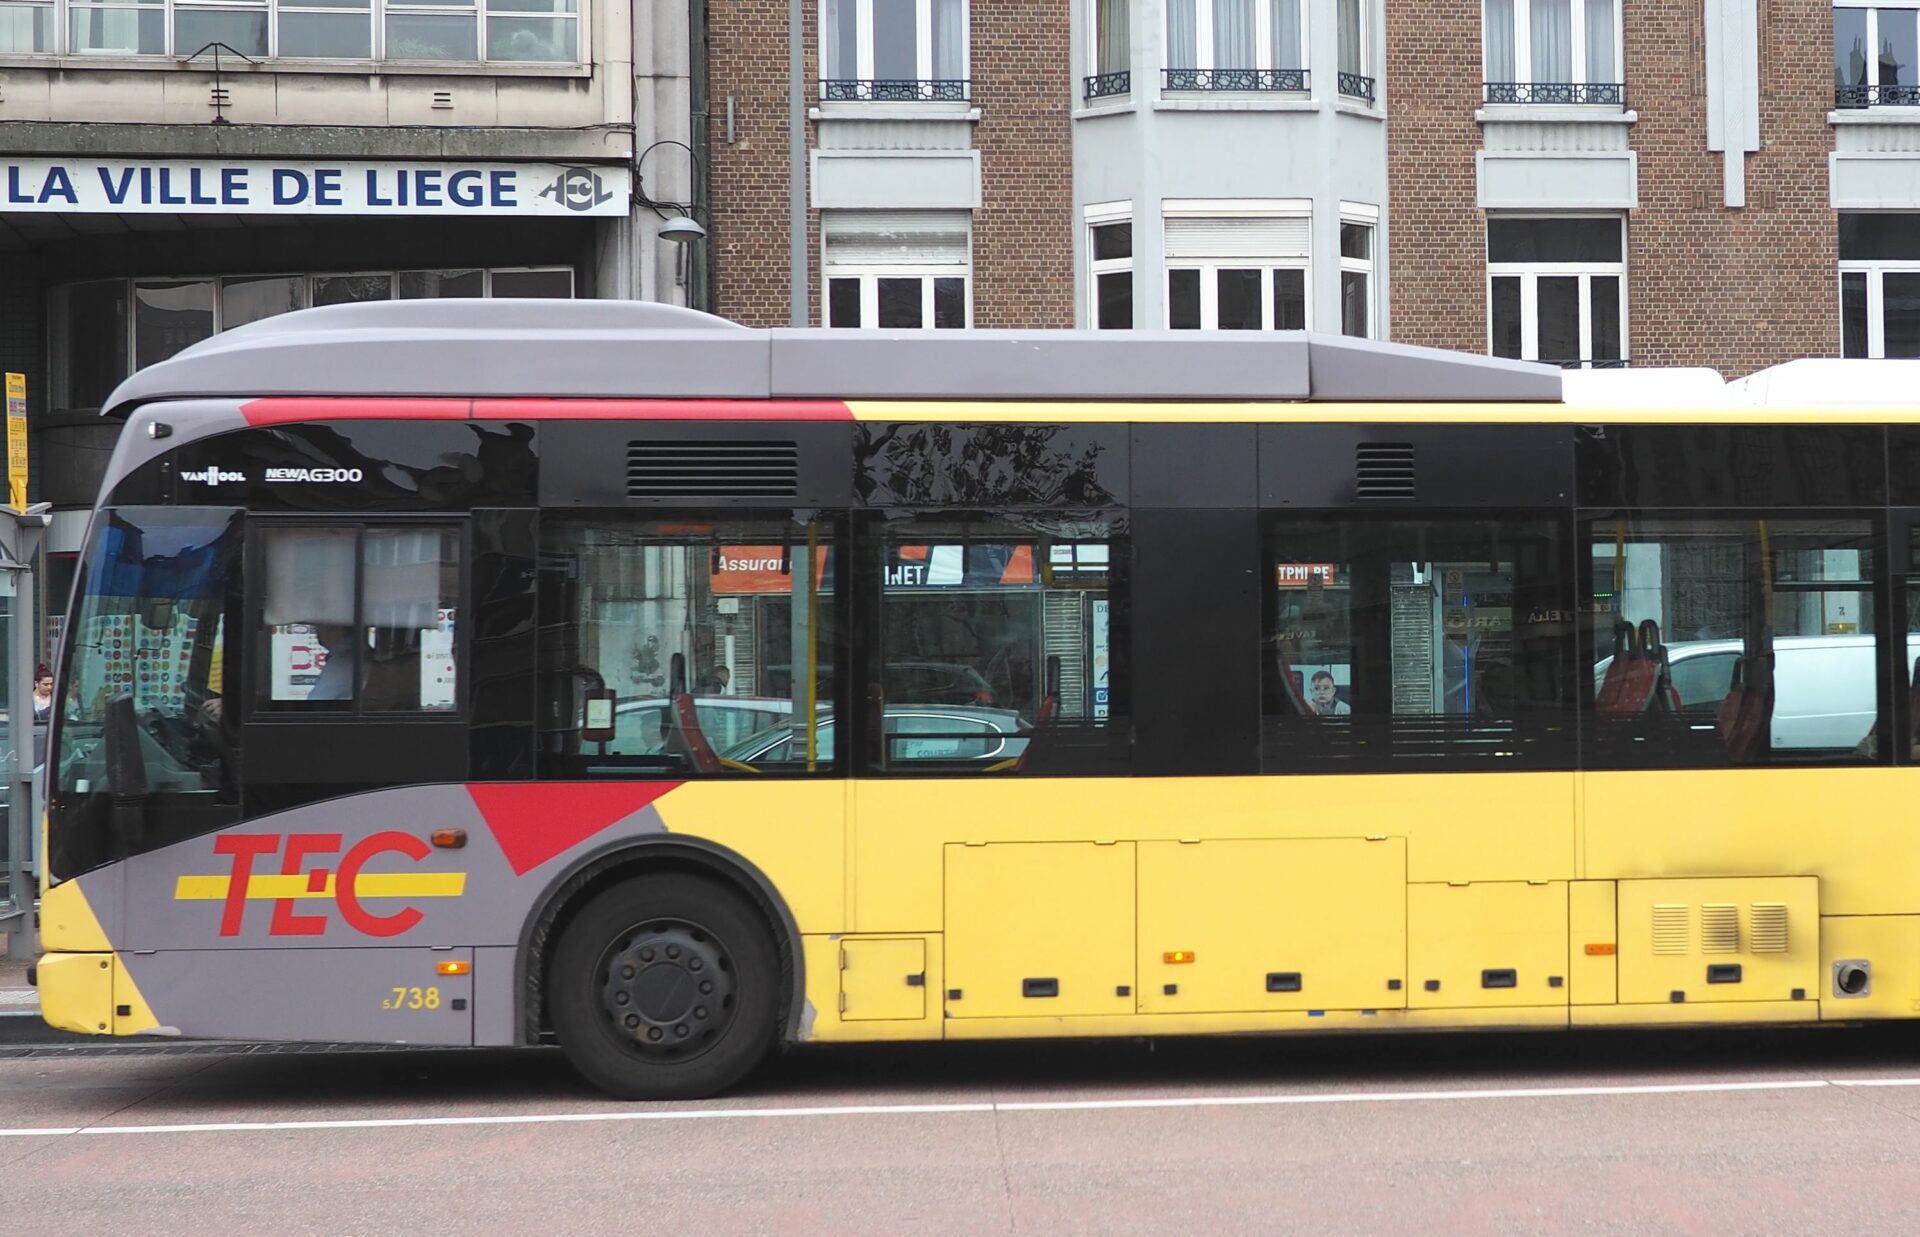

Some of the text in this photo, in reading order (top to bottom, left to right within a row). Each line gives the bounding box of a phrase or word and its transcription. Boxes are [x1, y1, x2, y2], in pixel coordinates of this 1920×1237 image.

[8, 166, 518, 207] LA VILLE DE LIEGE
[214, 831, 432, 938] TEC
